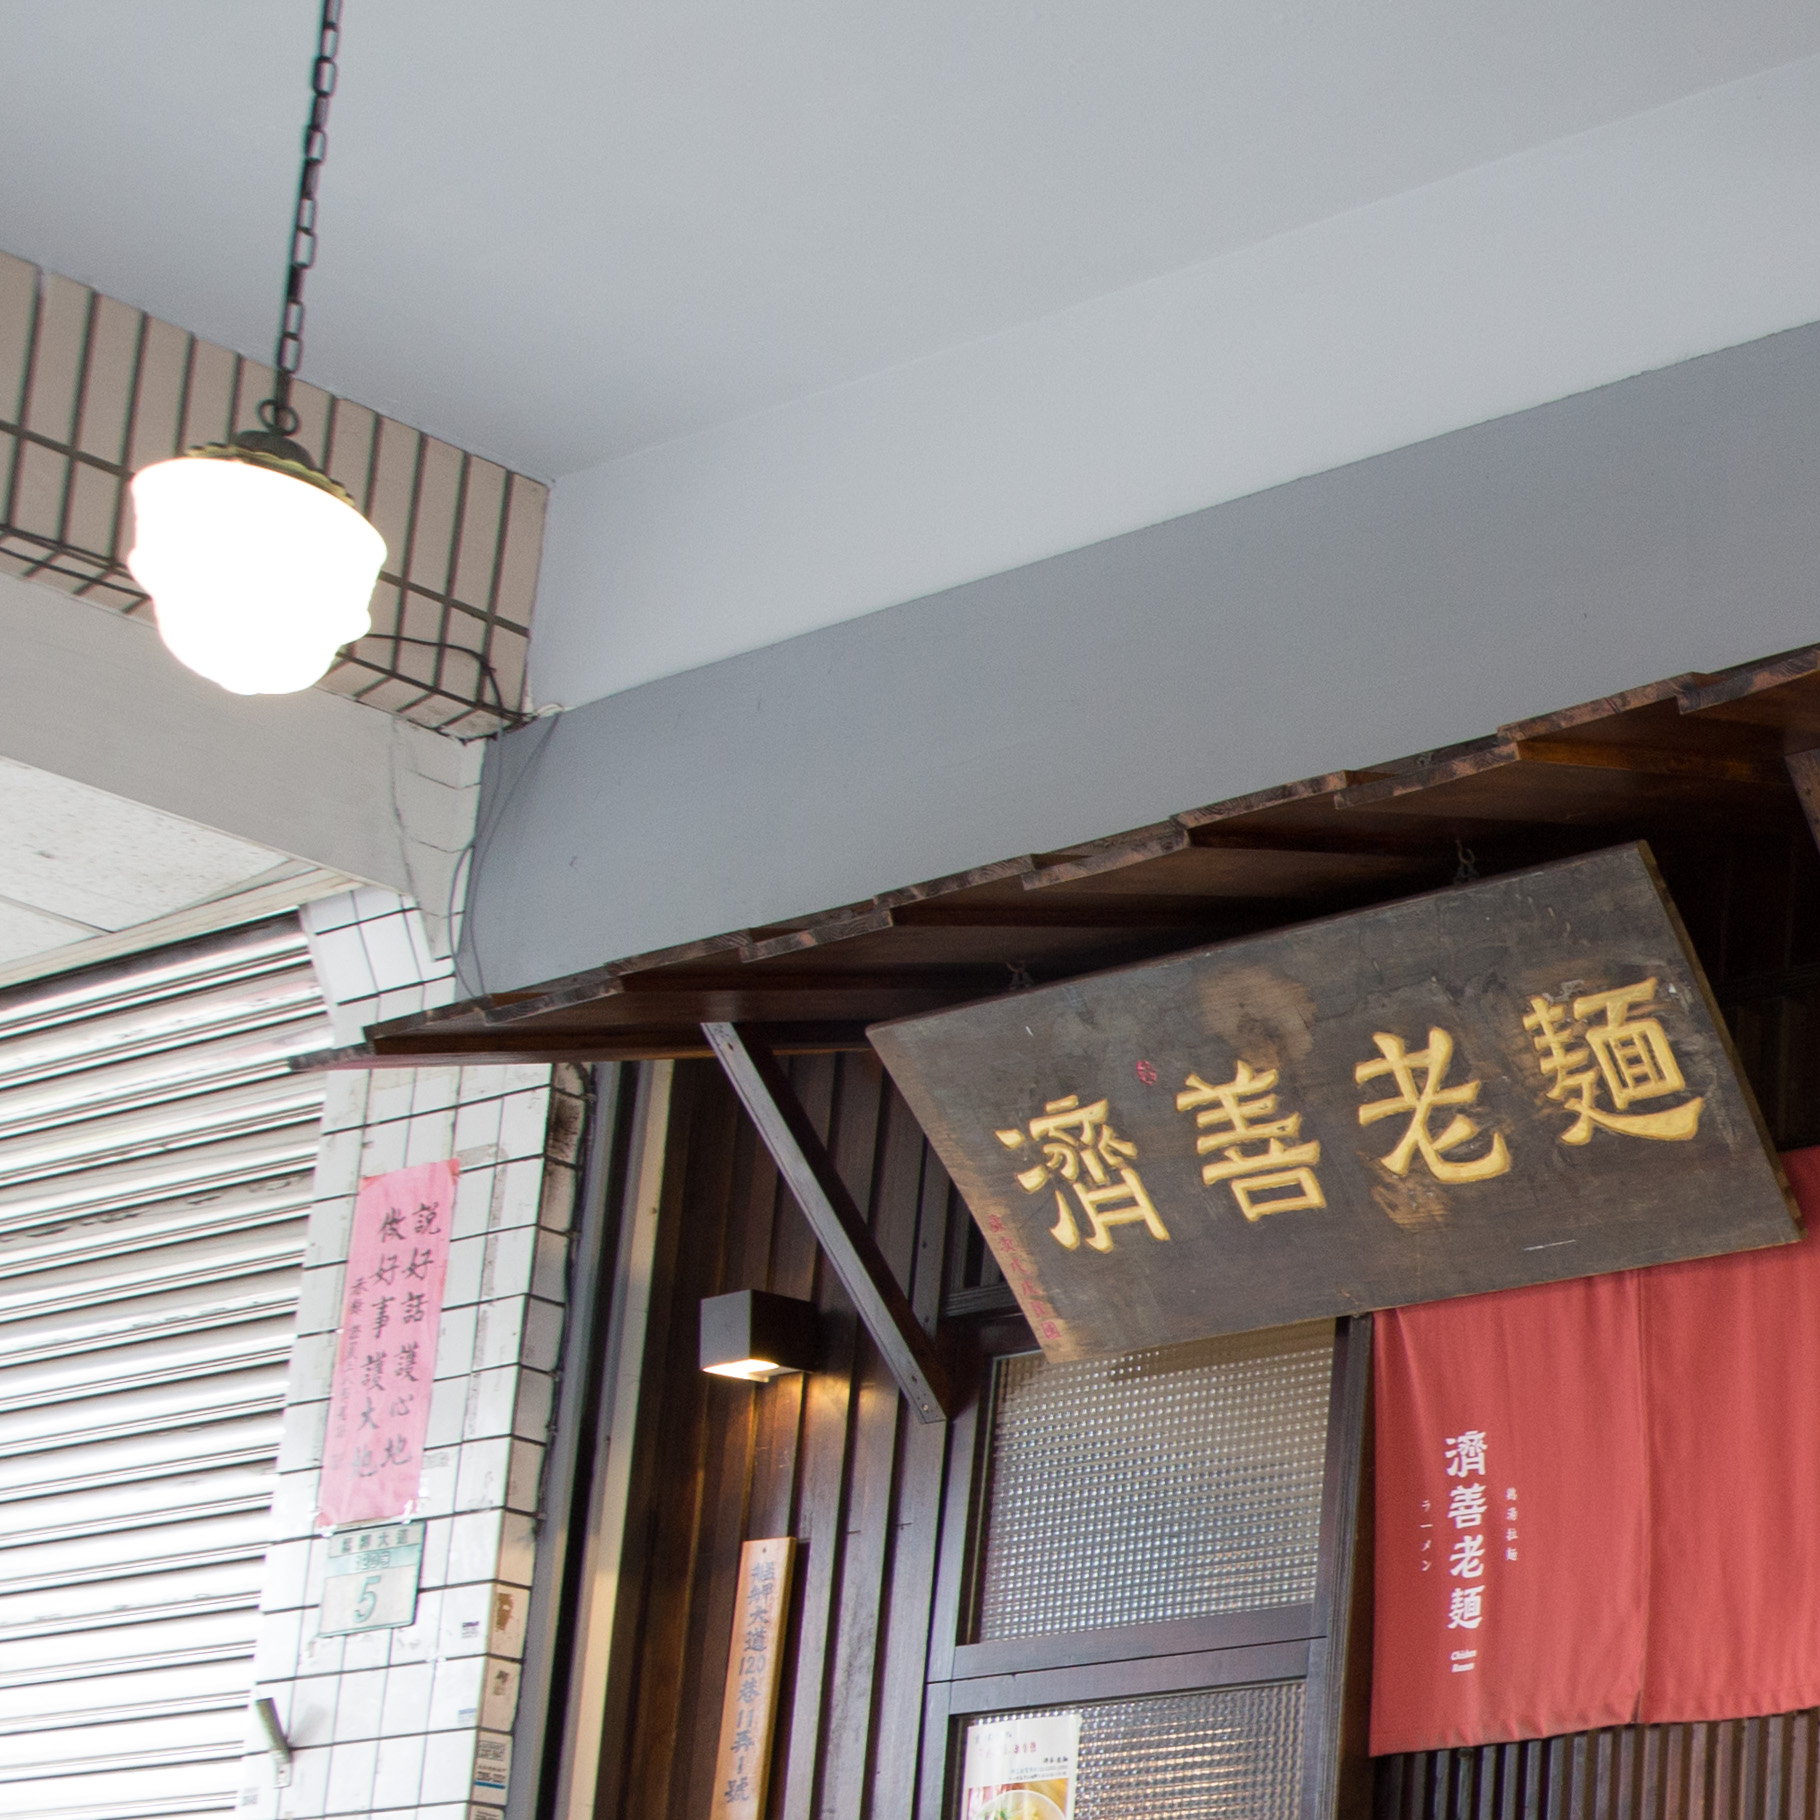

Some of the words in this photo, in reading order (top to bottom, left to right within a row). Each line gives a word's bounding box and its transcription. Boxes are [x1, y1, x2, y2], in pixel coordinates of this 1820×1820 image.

[1420, 1499, 1433, 1571] ラーメン
[354, 1575, 381, 1623] 5
